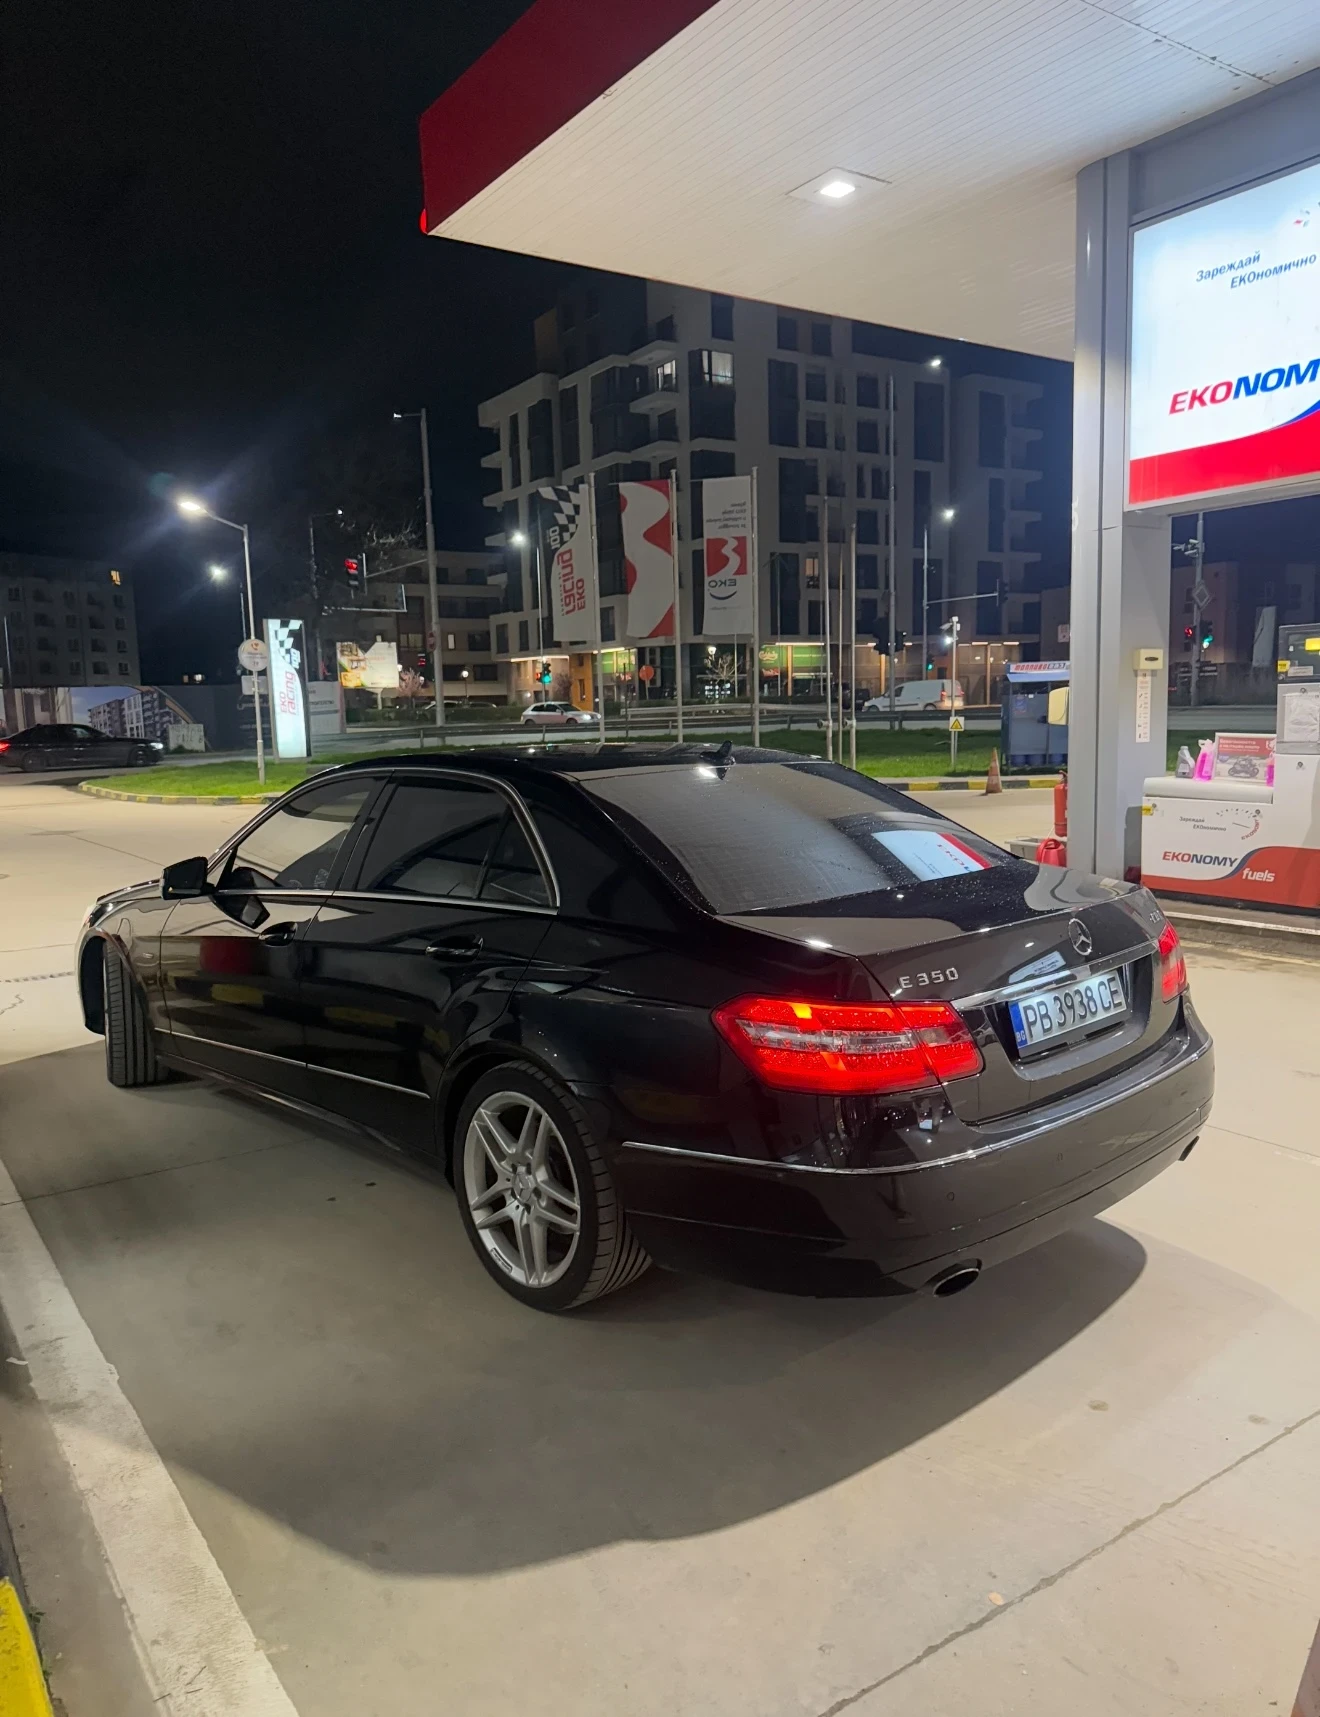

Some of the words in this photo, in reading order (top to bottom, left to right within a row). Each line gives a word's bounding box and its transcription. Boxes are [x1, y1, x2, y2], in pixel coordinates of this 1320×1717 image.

[1196, 250, 1261, 282] Зареждай
[279, 691, 288, 714] EKO
[285, 671, 297, 716] racing
[1162, 850, 1239, 868] EKONOMY
[1242, 867, 1276, 883] fuels
[899, 976, 913, 989] E
[916, 967, 959, 986] 350
[1022, 999, 1053, 1039] PB
[1053, 985, 1098, 1028] 3938
[1097, 976, 1123, 1011] CE
[1015, 1030, 1026, 1043] BG
